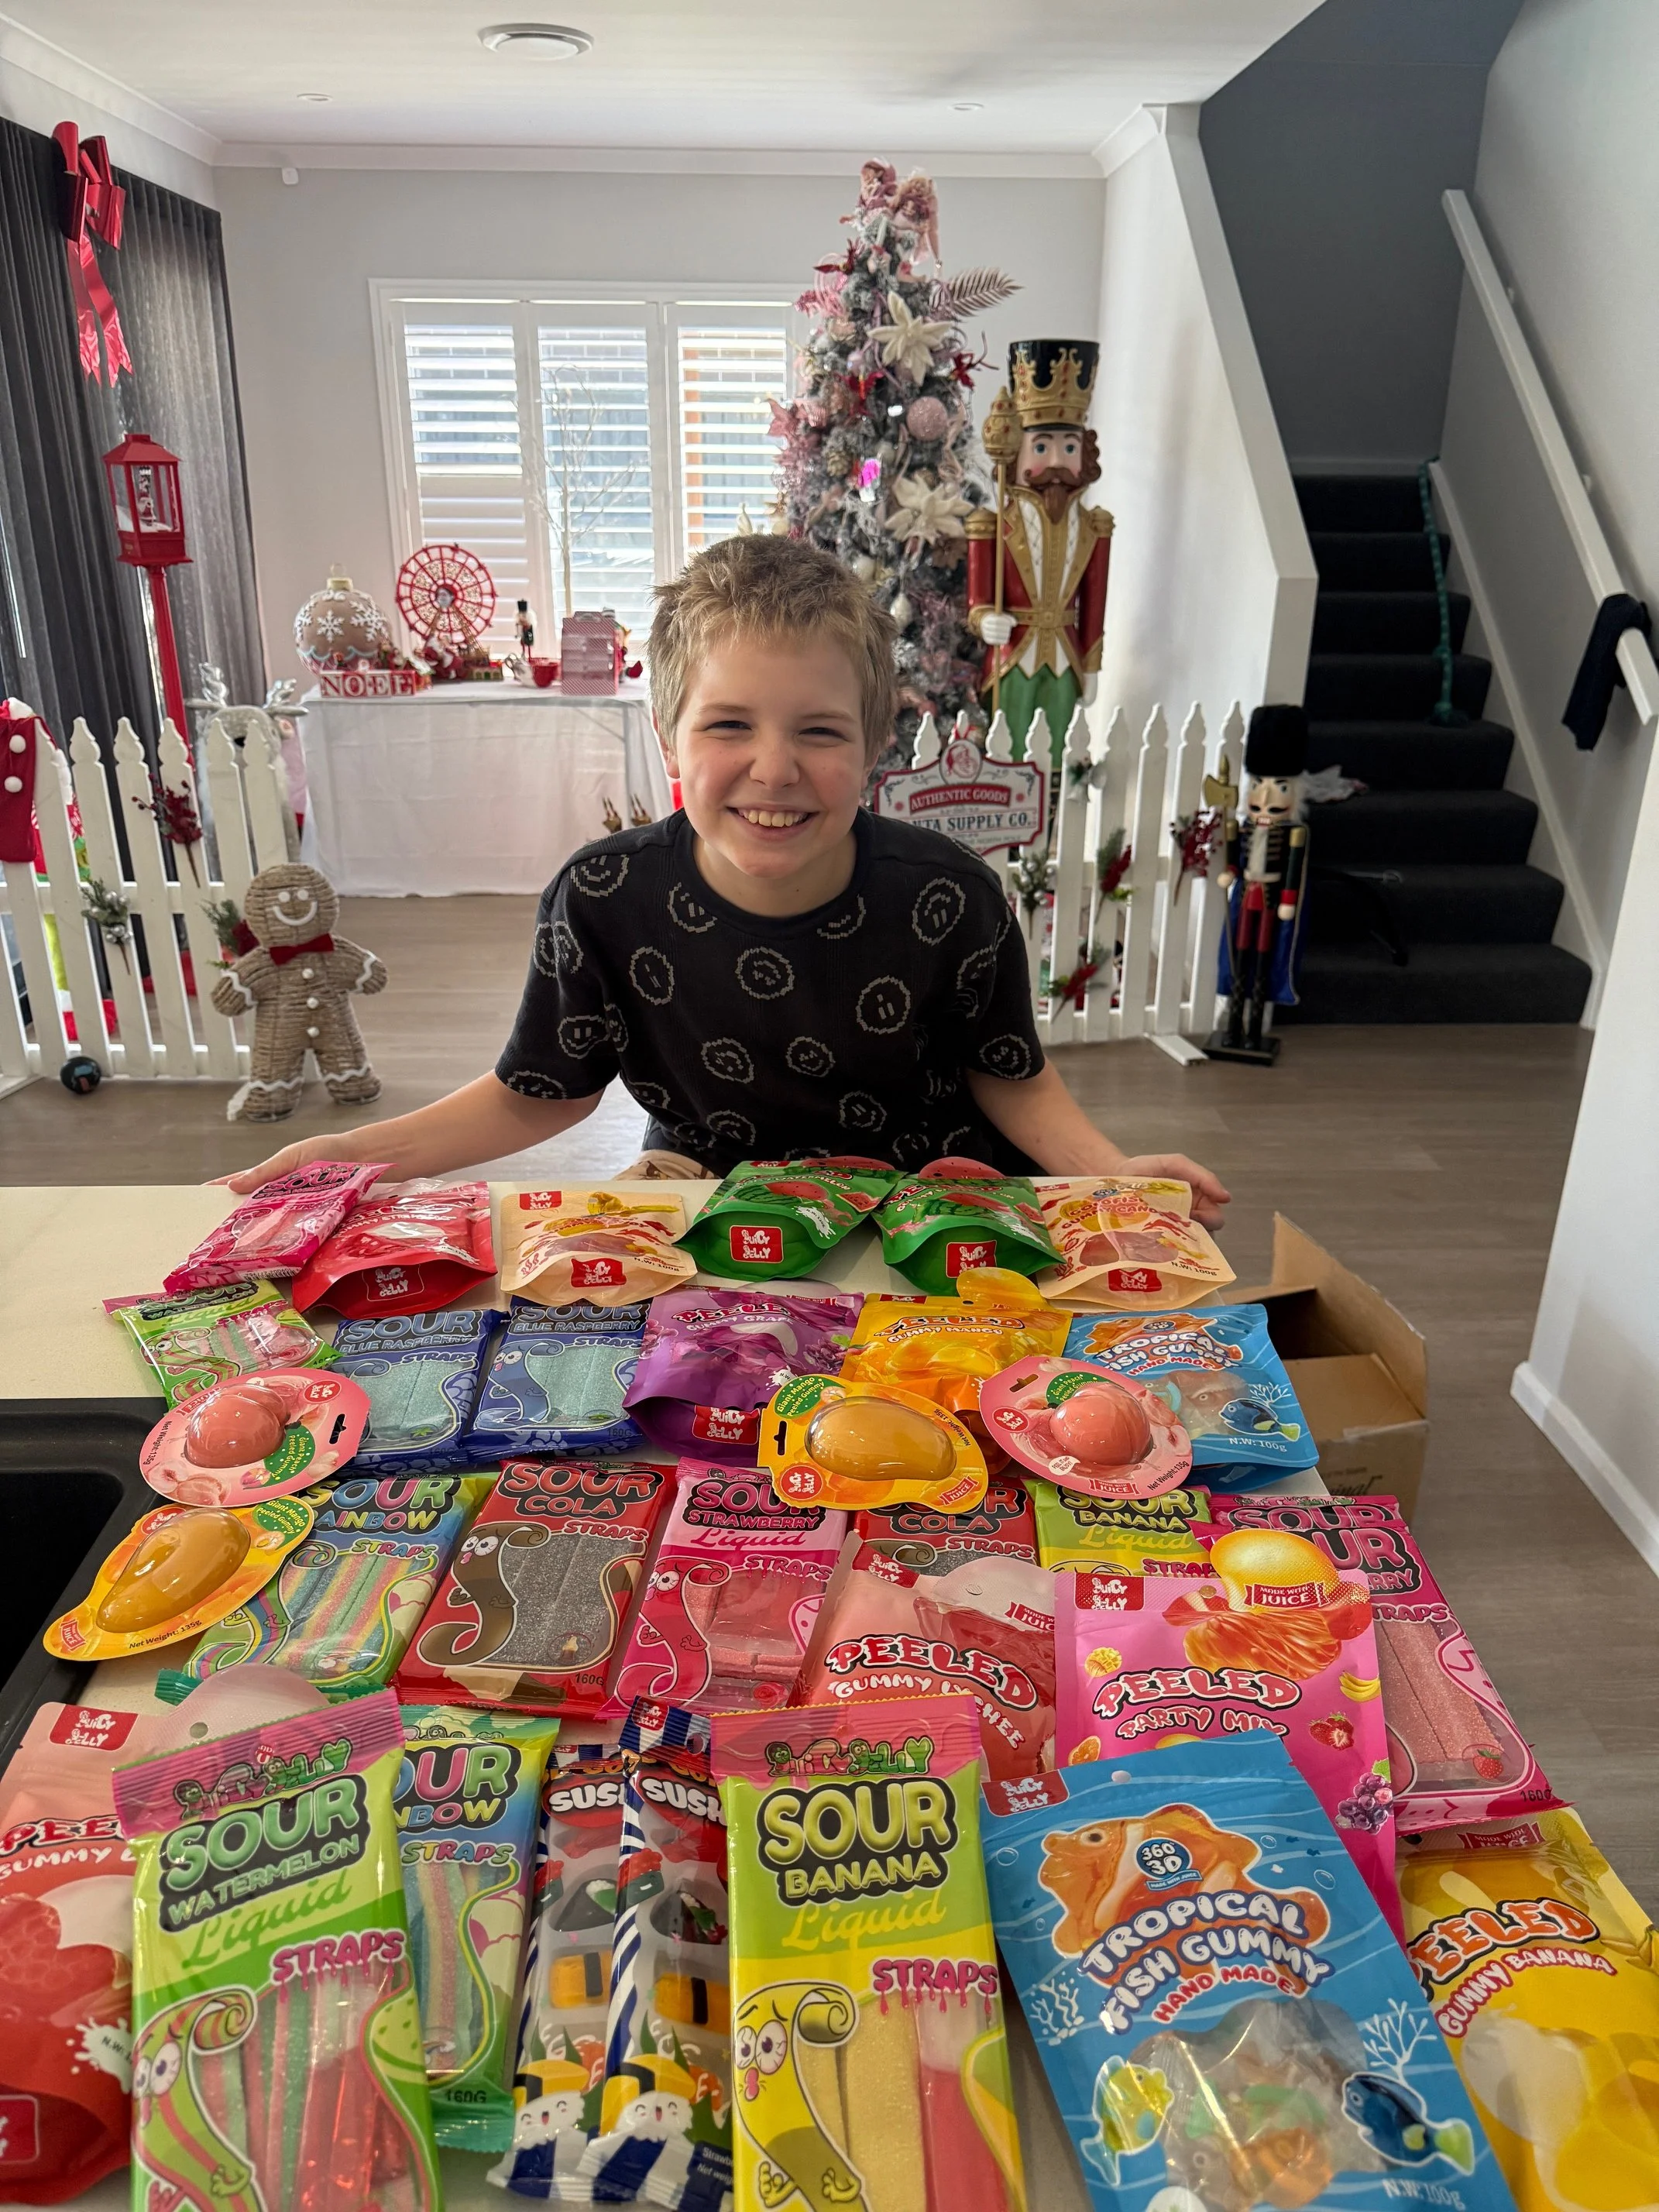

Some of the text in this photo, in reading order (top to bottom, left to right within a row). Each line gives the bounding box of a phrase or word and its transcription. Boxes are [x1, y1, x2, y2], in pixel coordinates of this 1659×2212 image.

[321, 673, 414, 696] NOEL
[911, 787, 1008, 810] AUTHENTIC GOODS
[946, 812, 1032, 832] SUPPLY CO.
[742, 1245, 771, 1259] JELLY
[517, 1306, 643, 1321] SOUR
[672, 1303, 808, 1324] PEELE
[686, 1315, 795, 1331] GUMMY GRAPE
[344, 1311, 476, 1344] SOUR
[513, 1320, 641, 1333] BLUE RASPBERRY
[888, 1326, 1003, 1343] GUMMY MANGO
[339, 1341, 380, 1354] BLUE
[574, 1336, 644, 1348] STRAPS
[401, 1352, 477, 1363] STRAPS
[1105, 1342, 1241, 1370] ISH GUMMY
[1128, 1356, 1215, 1376] HAND MADE
[776, 1376, 816, 1413] Giant Mango
[1052, 1373, 1084, 1396] Giant Peach
[1060, 1388, 1075, 1403] Peeled
[786, 1381, 826, 1417] Peeled Gummy
[706, 1423, 744, 1441] JELLY
[960, 1434, 971, 1446] Net
[290, 1436, 308, 1474] Giant Peach
[1229, 1437, 1288, 1452] N.W: 100g
[271, 1455, 296, 1480] Gummy
[504, 1463, 656, 1498] SOUR
[802, 1472, 816, 1494] JELLY
[949, 1482, 971, 1501] JUICE
[1100, 1484, 1129, 1493] JUICE
[1147, 1479, 1160, 1491] Net
[302, 1478, 454, 1510] SOUR
[692, 1482, 820, 1515] SOU
[1063, 1489, 1194, 1515] SOUR
[268, 1499, 307, 1527] Giant Mango
[524, 1495, 617, 1516] COLA
[257, 1506, 297, 1535] Peeled Gummy
[314, 1510, 438, 1530] AINBOW
[564, 1520, 648, 1540] STRAPS
[688, 1510, 820, 1529] STRAWBERRY
[897, 1514, 994, 1532] COLA
[1079, 1510, 1187, 1530] BANANA
[352, 1538, 438, 1558] STRAPS
[690, 1528, 806, 1550] Liquid
[945, 1536, 1035, 1558] STRAPS
[1078, 1526, 1194, 1550] Liquid
[744, 1554, 833, 1581] STRAPS
[1142, 1558, 1220, 1578] STRAP
[1259, 1585, 1287, 1595] MADE
[1262, 1590, 1312, 1606] JUICE
[1022, 1606, 1046, 1620] MADE
[1091, 1594, 1128, 1611] JELLY
[1372, 1605, 1448, 1622] TRAPS
[1020, 1613, 1055, 1632] JUIC
[62, 1626, 78, 1646] JUICE
[129, 1620, 203, 1650] Net Weight: 135g
[575, 1673, 605, 1685] 160G
[826, 1635, 1038, 1710] PEELED
[833, 1673, 933, 1698] GUMMY
[1093, 1667, 1301, 1718] PEELED
[1116, 1705, 1287, 1738] PARTY MIX
[64, 1728, 109, 1747] JELLY
[848, 1737, 933, 1776] JELLY
[548, 1781, 625, 1813] SUS
[641, 1778, 728, 1827] SUSH
[1008, 1792, 1049, 1813] JELLY
[764, 1780, 952, 1865] SOUR
[1503, 1827, 1527, 1840] WITH
[0, 1815, 122, 1856] PEE
[166, 1778, 360, 1891] SOUR
[401, 1840, 514, 1863] STRAPS
[1141, 1842, 1175, 1861] 360
[0, 1846, 112, 1881] GUMMY
[785, 1851, 941, 1898] BANANA
[1146, 1854, 1183, 1876] 3D
[167, 1833, 360, 1925] WATERMELON
[1180, 1871, 1197, 1881] JUICE
[181, 1869, 353, 1970] Liquid
[781, 1888, 946, 1954] Liquid
[1083, 1891, 1305, 1977] TROPICAL
[1410, 1899, 1600, 1990] EELED
[271, 1930, 406, 1987] STRAPS
[872, 1959, 998, 2002] STRAPS
[1102, 1927, 1331, 2034] FISH GUMMY
[1152, 1965, 1296, 2023] HAND MADE
[1437, 1948, 1617, 2037] GUMMY BANANA
[445, 2088, 487, 2104] 160G
